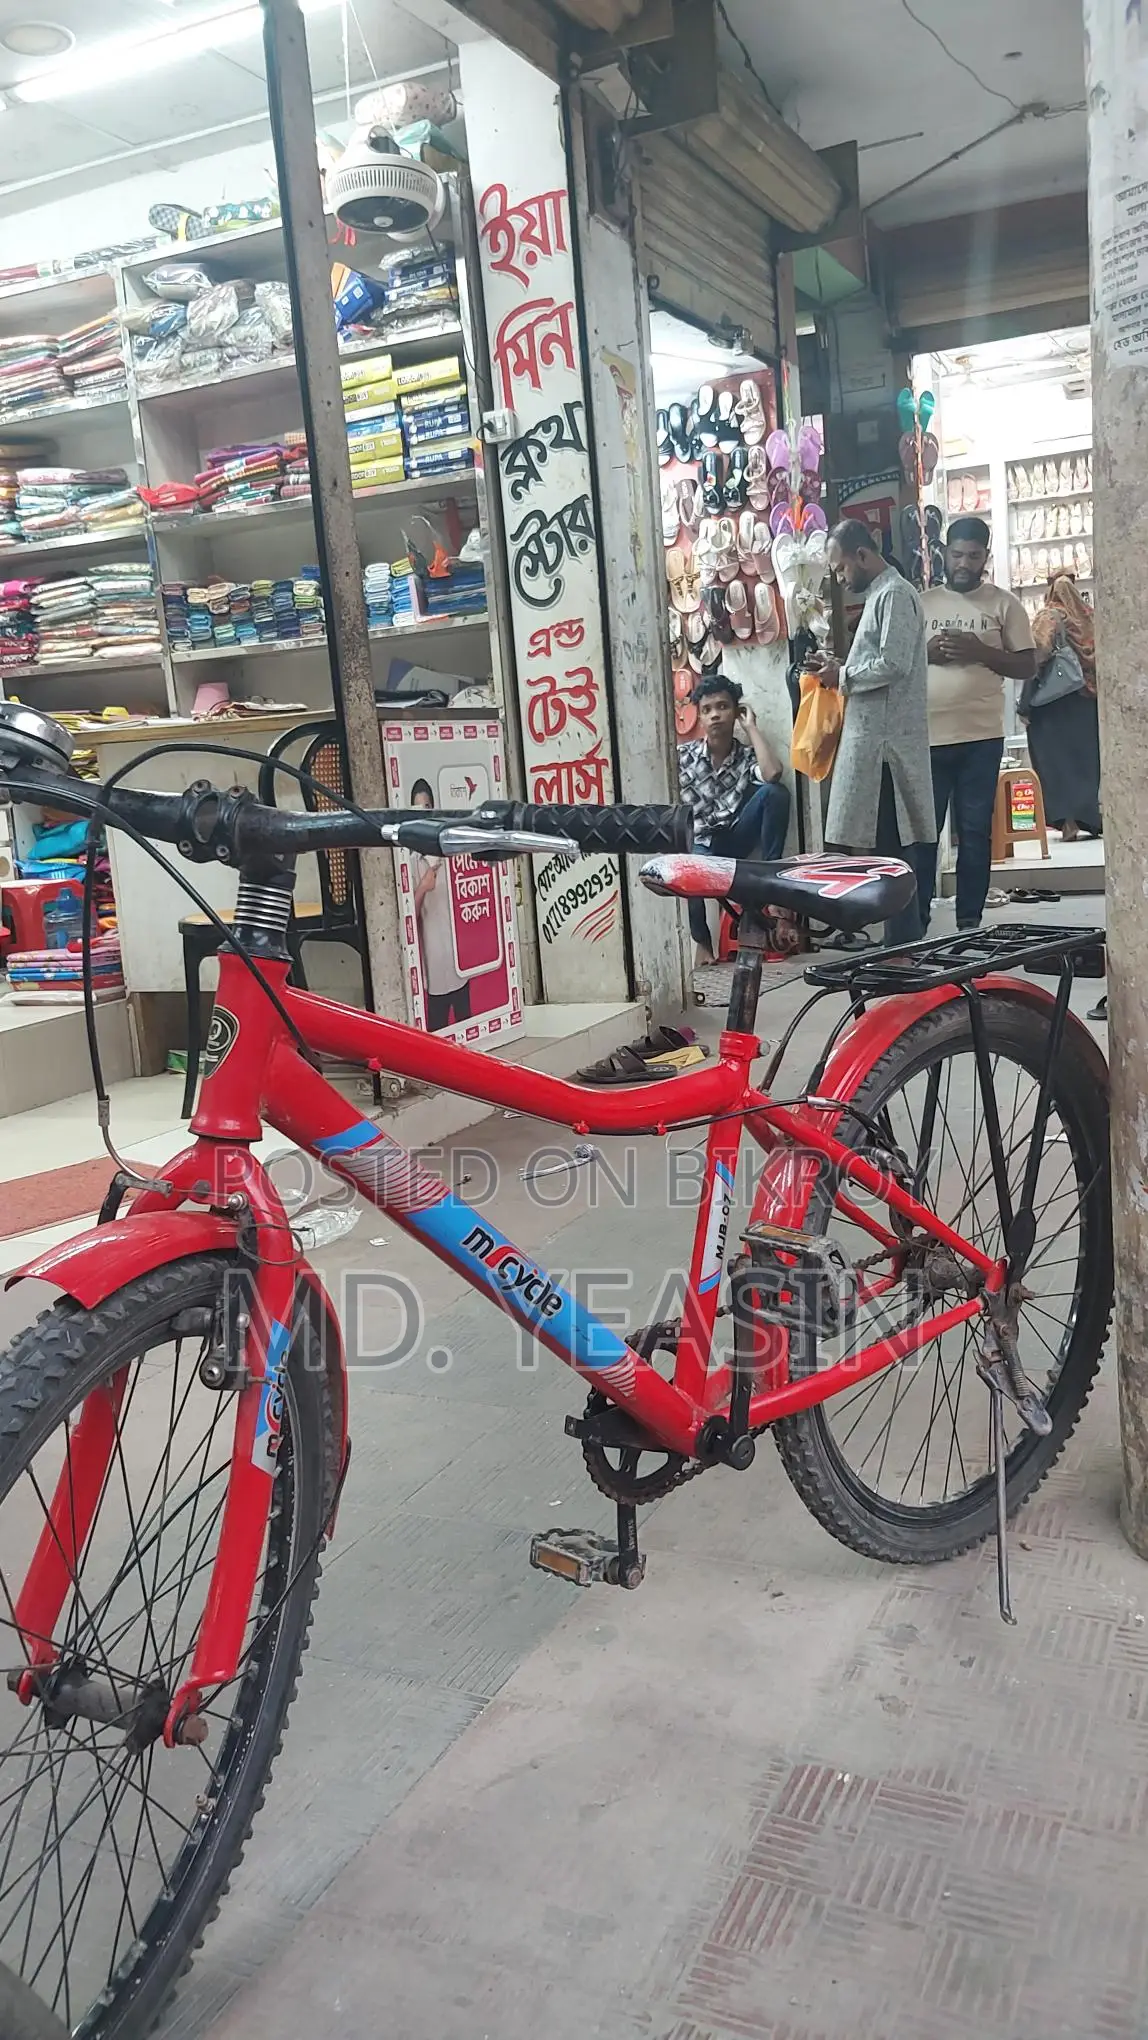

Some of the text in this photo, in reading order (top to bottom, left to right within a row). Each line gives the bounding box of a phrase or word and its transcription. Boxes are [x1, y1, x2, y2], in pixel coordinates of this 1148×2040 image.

[479, 183, 568, 288] ইয়া
[493, 297, 576, 410] মিন
[510, 494, 595, 607] স্টোর
[528, 618, 585, 657] এন্ড
[526, 666, 599, 743] টেই
[530, 738, 609, 805] লার্স
[455, 873, 490, 900] বিকাশ
[460, 898, 490, 923] করুন
[542, 857, 619, 944] 01718992931
[715, 1193, 732, 1260] MJB-07
